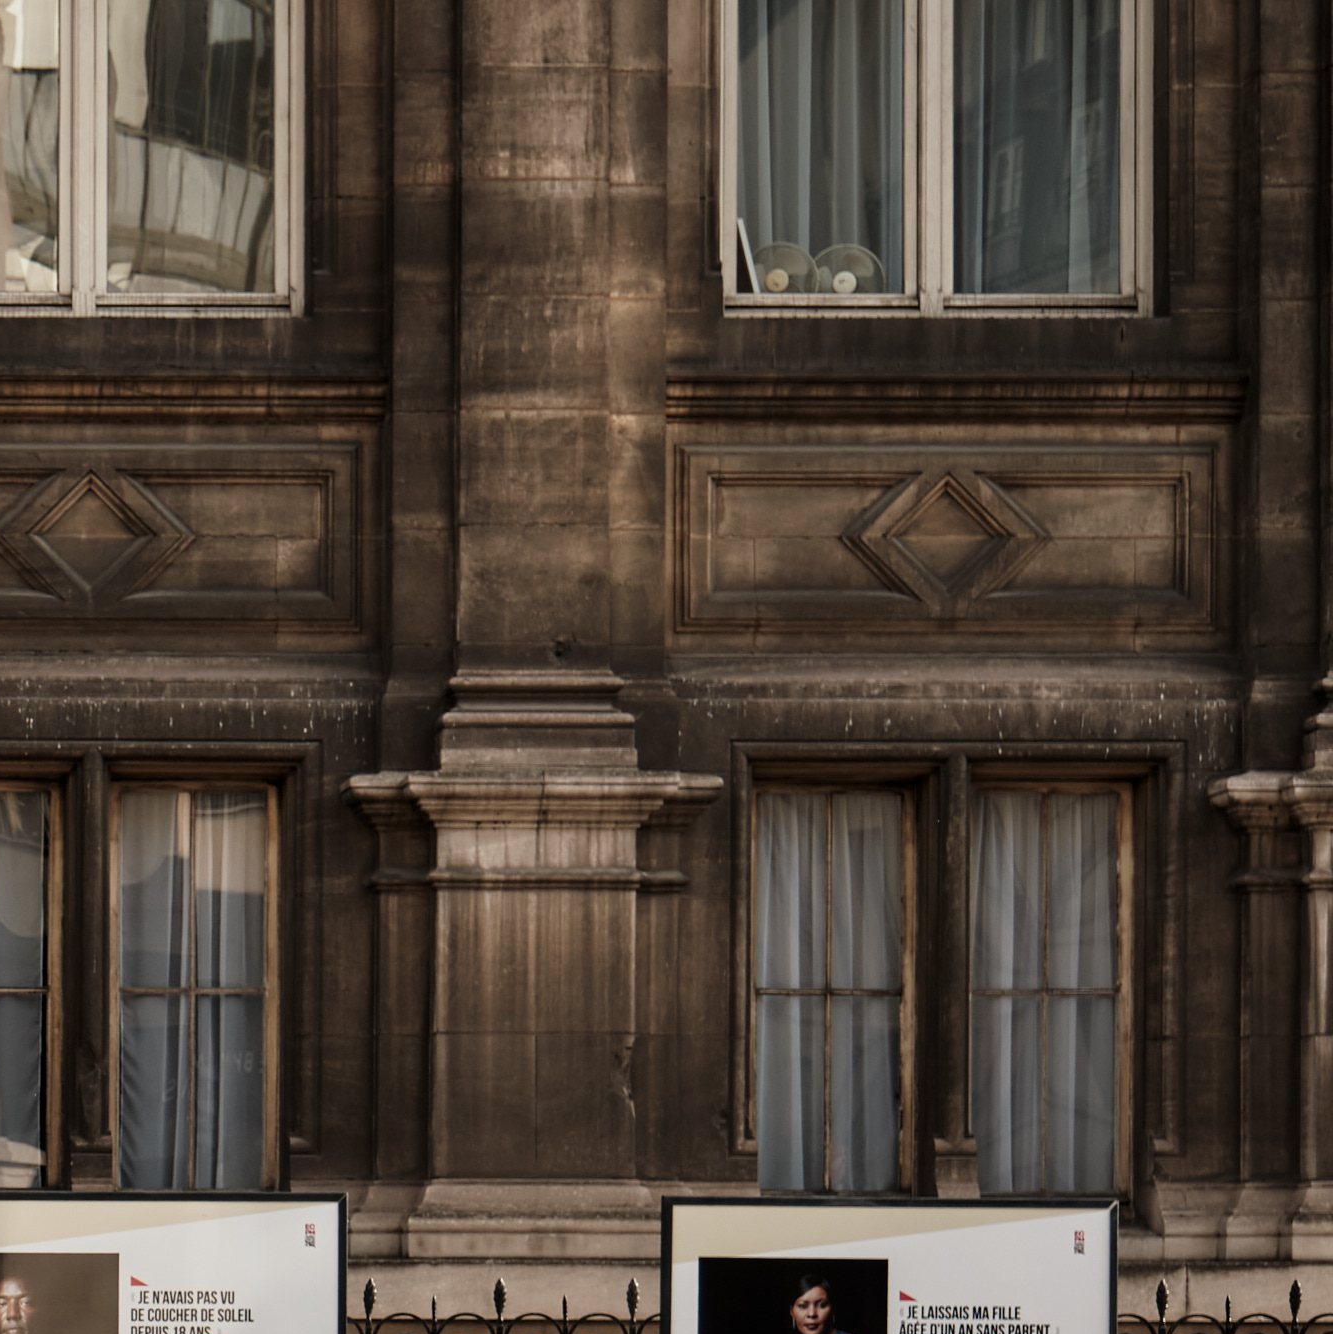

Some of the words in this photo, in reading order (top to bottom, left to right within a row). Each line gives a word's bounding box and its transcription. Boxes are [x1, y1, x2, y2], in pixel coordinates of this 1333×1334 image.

[138, 1291, 149, 1304] JE
[152, 1291, 194, 1304] N'AVAIS
[197, 1291, 218, 1304] PAS
[220, 1291, 235, 1304] VU
[130, 1308, 144, 1322] DE
[147, 1309, 198, 1322] COUCHER
[200, 1309, 214, 1322] DE
[217, 1309, 254, 1322] SOLEIL
[906, 1306, 918, 1319] JE
[921, 1306, 970, 1319] LAISSAIS
[972, 1306, 990, 1320] MA
[992, 1306, 1021, 1320] FILLE
